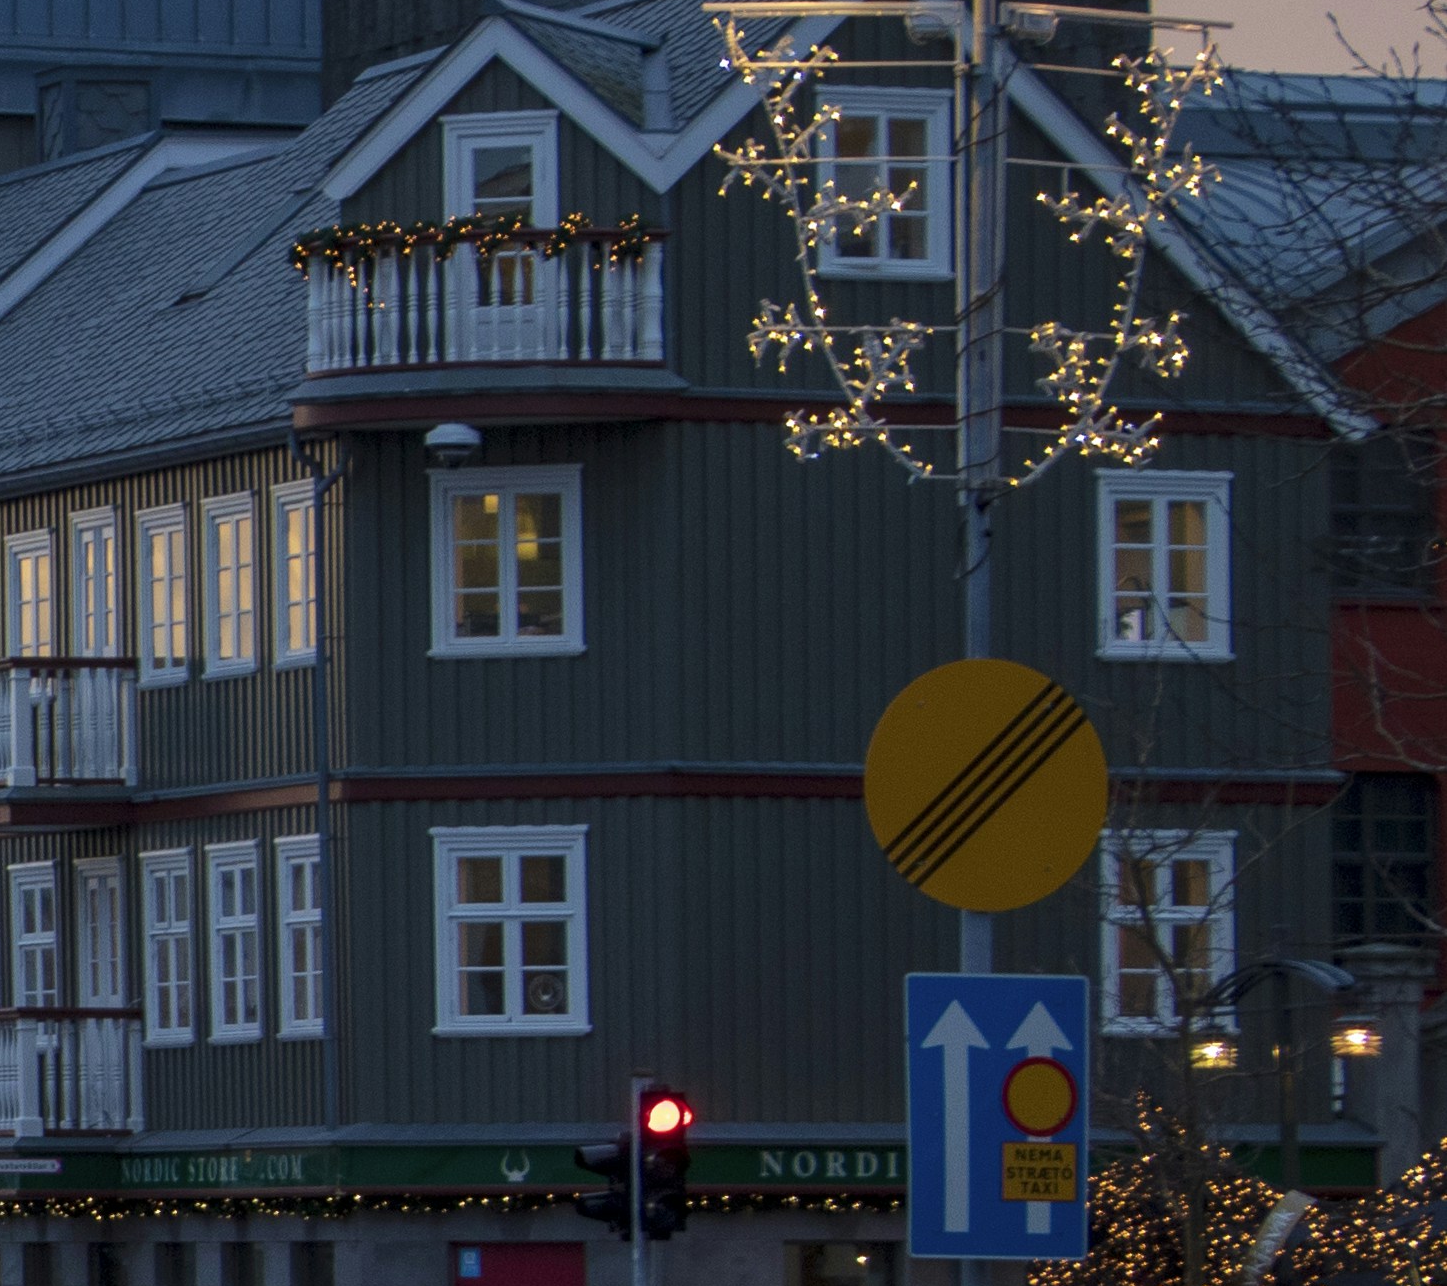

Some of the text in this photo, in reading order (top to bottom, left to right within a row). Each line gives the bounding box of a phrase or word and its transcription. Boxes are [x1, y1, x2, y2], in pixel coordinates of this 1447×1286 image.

[760, 1150, 900, 1178] NORDI
[1015, 1148, 1064, 1162] NEMA
[120, 1157, 180, 1183] NORDIC
[188, 1156, 239, 1182] STORE
[1007, 1162, 1073, 1180] STRÆTÓ
[1021, 1180, 1059, 1194] TAXI
